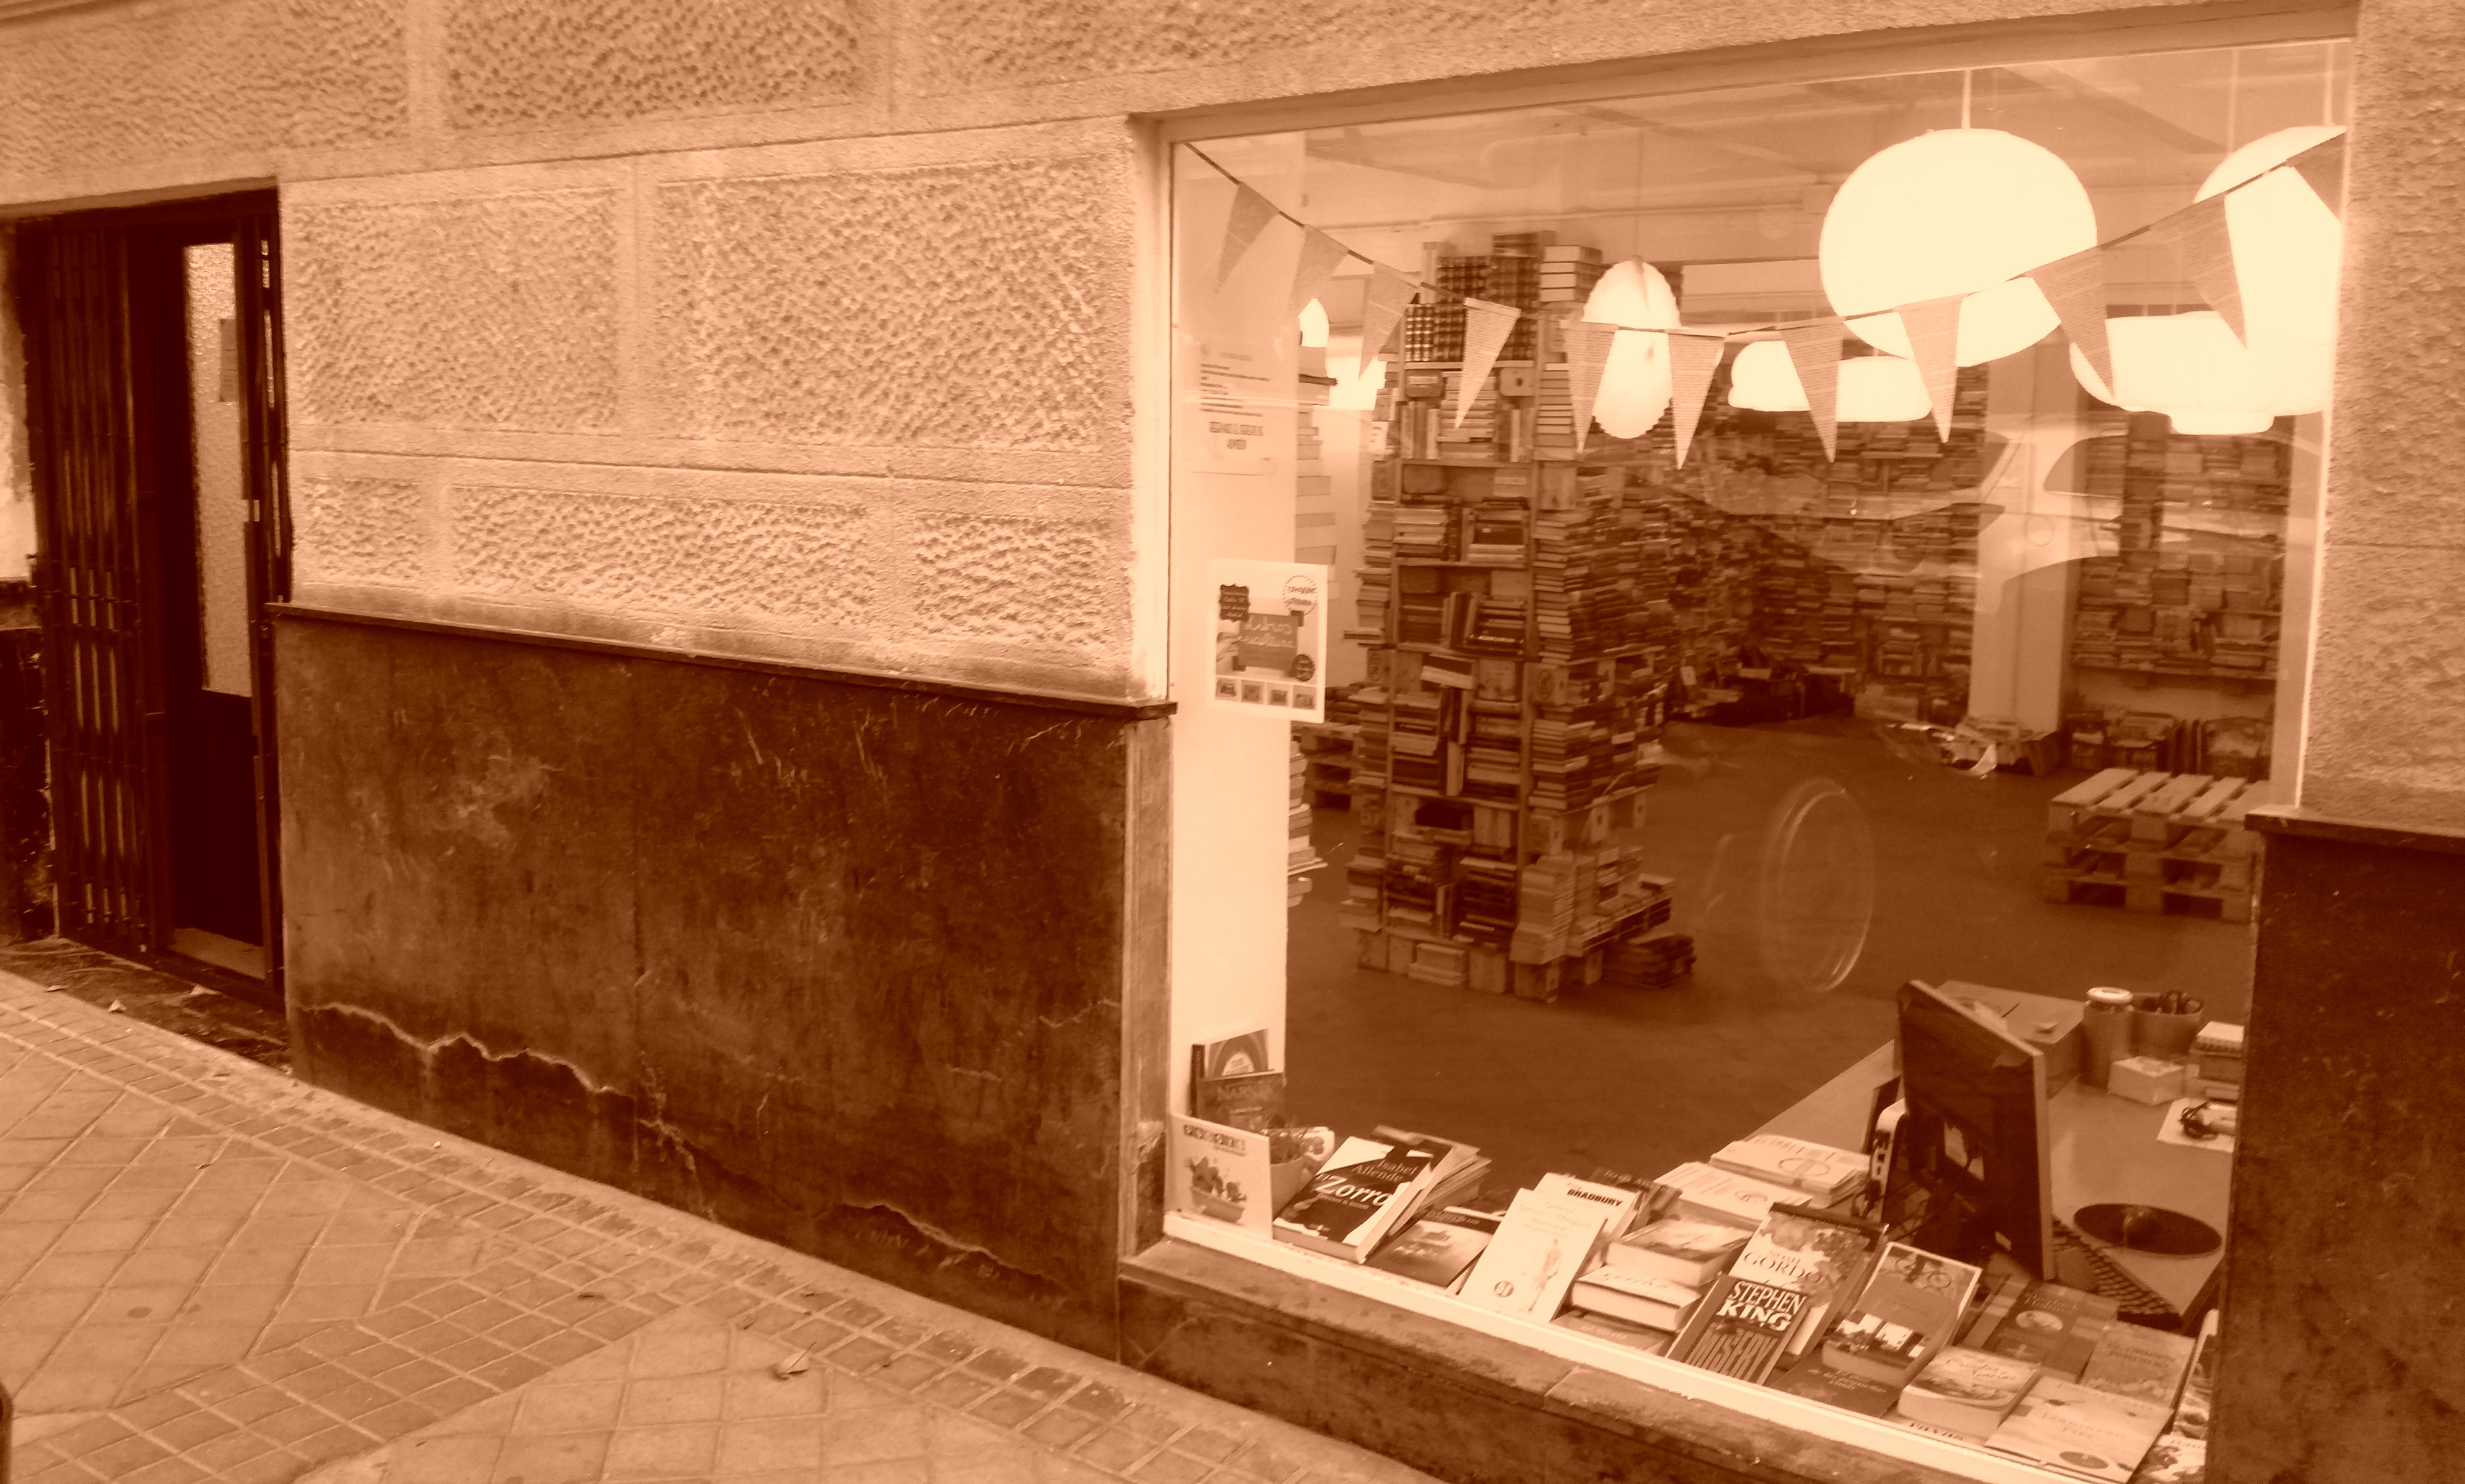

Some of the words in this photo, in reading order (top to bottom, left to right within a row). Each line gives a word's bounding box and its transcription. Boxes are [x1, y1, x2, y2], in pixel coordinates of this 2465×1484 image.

[1351, 1165, 1403, 1183] Allende
[1314, 1175, 1391, 1206] Zorro
[1567, 1189, 1623, 1207] BRADBURY
[1727, 1281, 1807, 1315] STEPHEN
[1716, 1298, 1793, 1332] KING
[1684, 1322, 1778, 1382] MISERY
